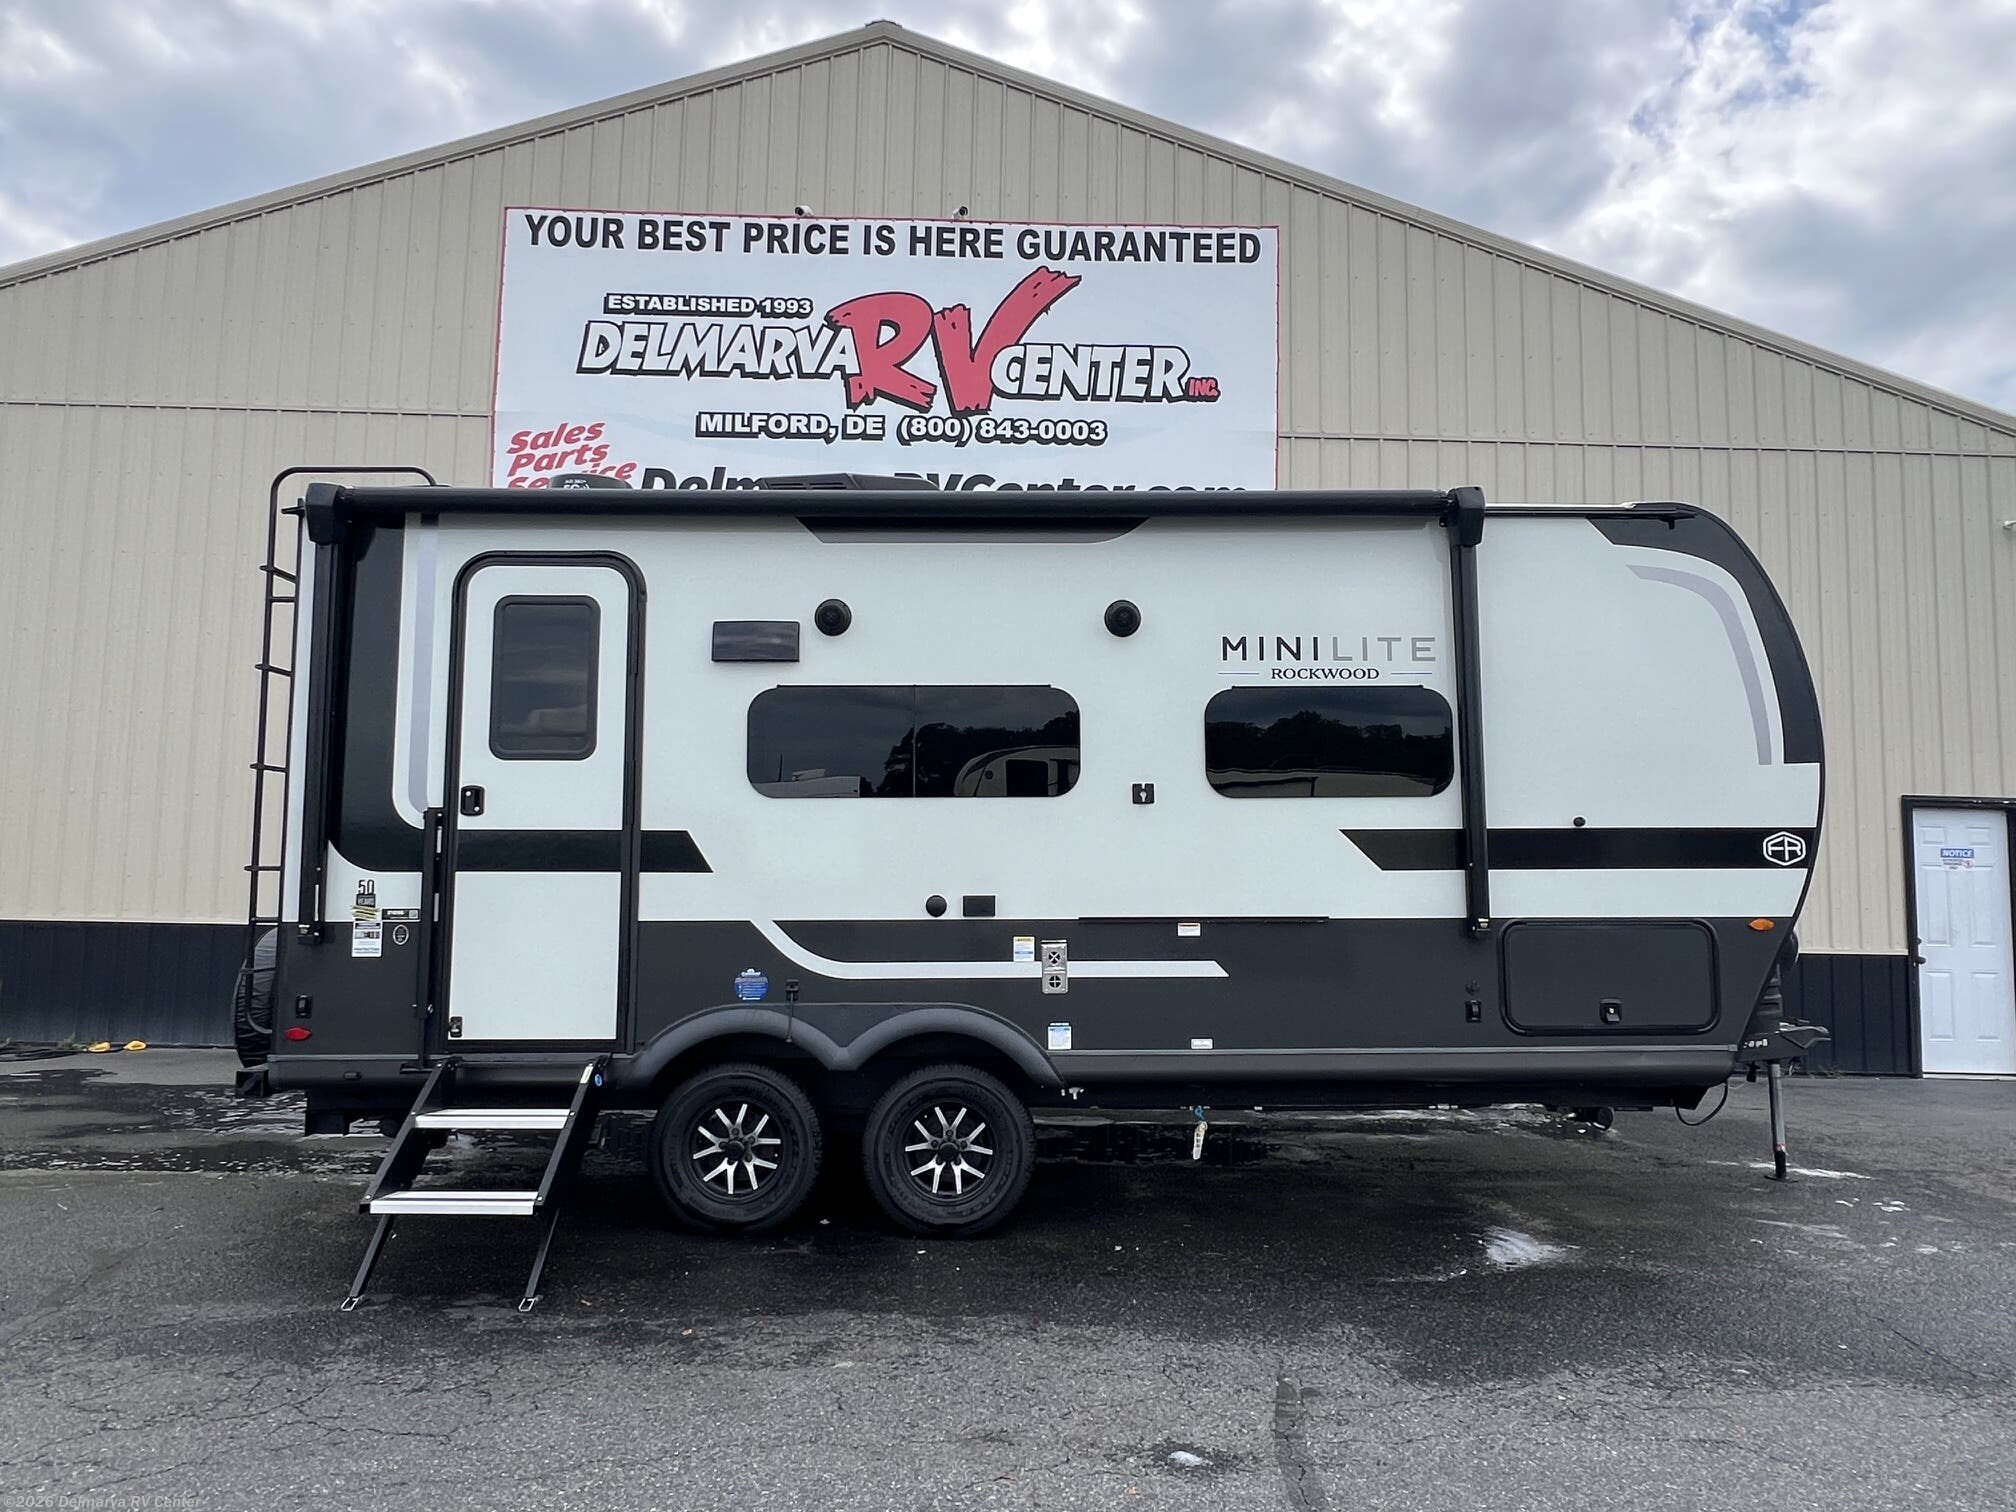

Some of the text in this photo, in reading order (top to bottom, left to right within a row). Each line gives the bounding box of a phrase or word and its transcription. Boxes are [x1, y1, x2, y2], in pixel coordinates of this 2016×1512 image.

[524, 214, 1261, 263] YOUR BEST PRICE IS HERE GUARANTEED
[604, 294, 813, 318] ESTABLISHED 1993
[577, 266, 1221, 416] DELMARVA RV CENTER INC.
[507, 422, 606, 454] Sales
[695, 411, 1108, 447] MILFORD, DE (800) 843-0003
[507, 444, 610, 477] Parts
[1271, 668, 1380, 680] ROCKWOOD
[1942, 849, 1973, 857] NOTICE
[358, 879, 375, 895] 50
